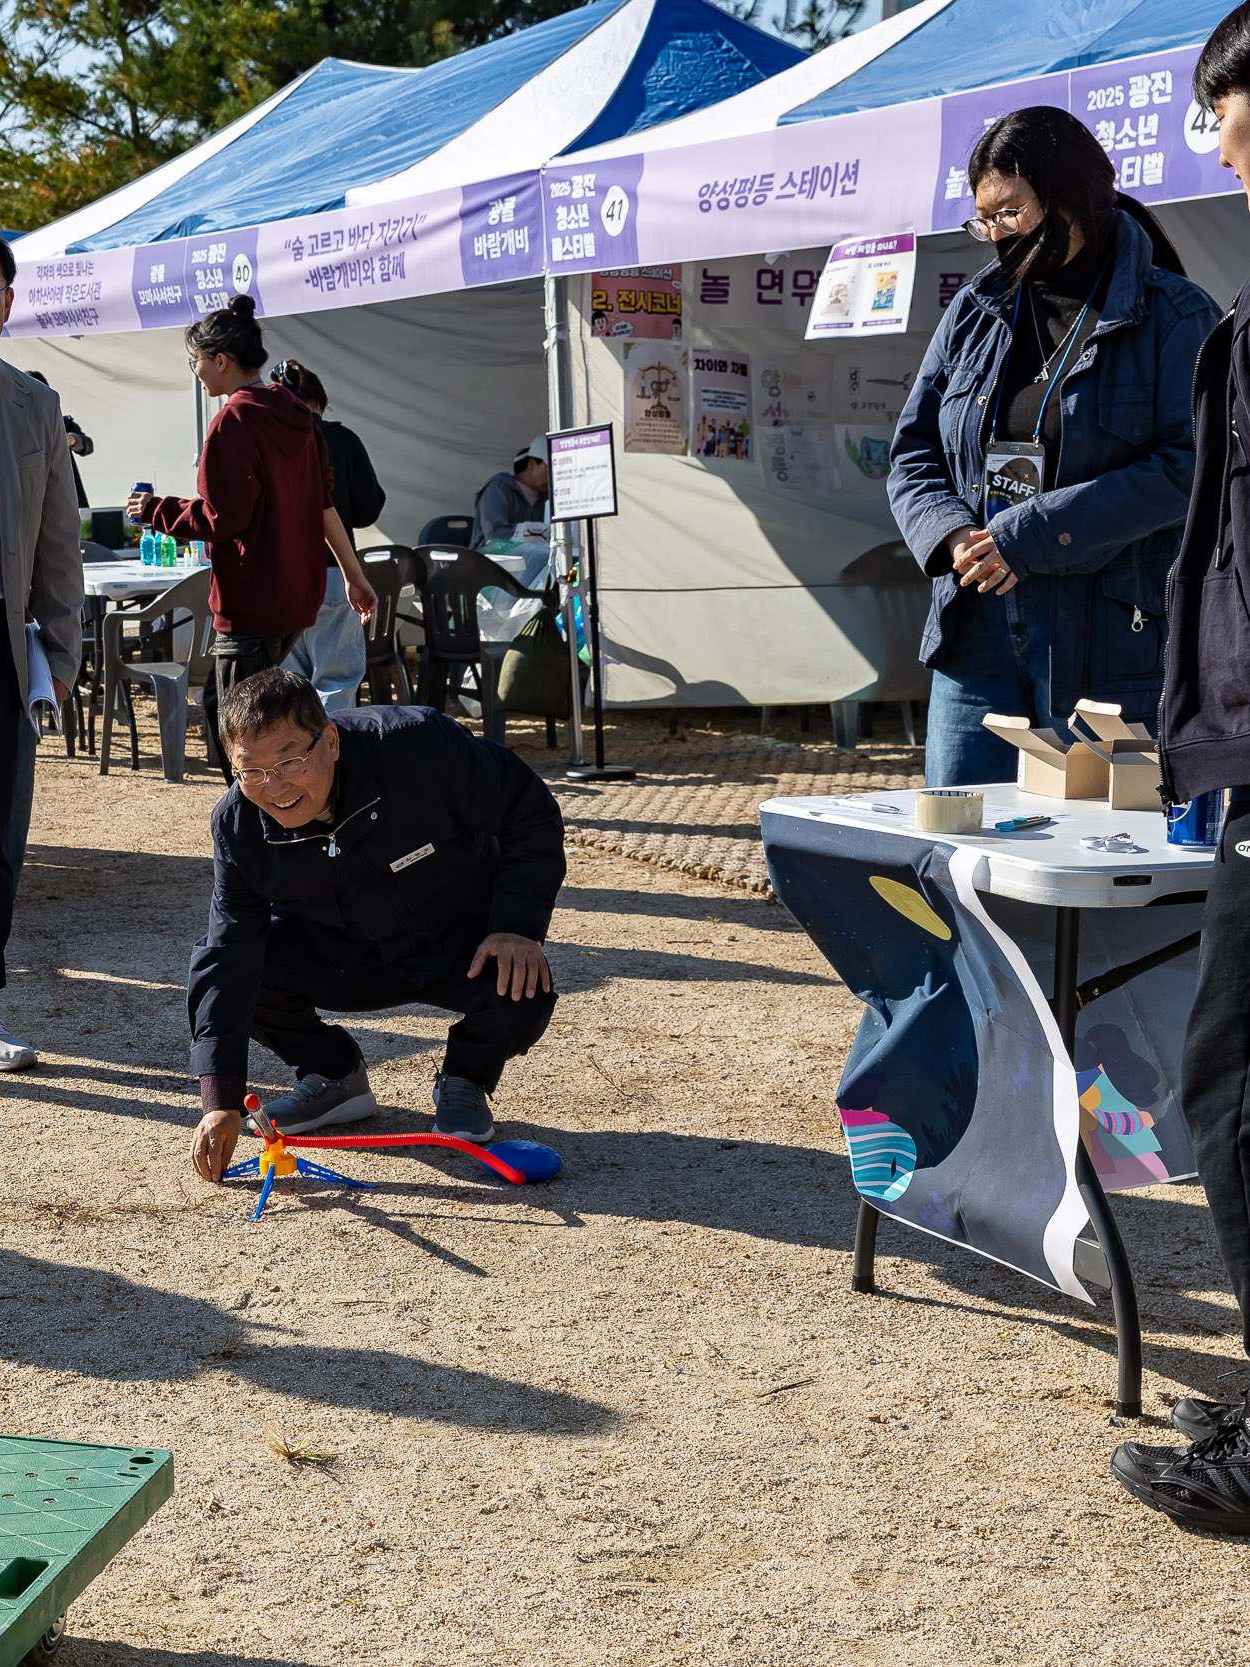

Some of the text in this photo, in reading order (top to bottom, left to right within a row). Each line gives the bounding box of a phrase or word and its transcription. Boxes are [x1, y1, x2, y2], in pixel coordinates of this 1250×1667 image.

[1087, 69, 1173, 111] 2025 광진
[1095, 112, 1159, 152] 청소년
[550, 173, 596, 199] 2025 광진
[698, 158, 860, 213] 양성평등 스테이션
[556, 203, 589, 231] 청소년
[606, 199, 623, 221] 41
[307, 230, 344, 257] 고르고
[349, 223, 375, 252] 바다
[473, 225, 529, 260] 바람개비
[551, 233, 596, 261] 페스티벌
[192, 243, 226, 264] 2025 광진
[37, 264, 55, 281] 각자의
[56, 262, 74, 279] 색으로
[195, 268, 224, 290] 청소년
[235, 265, 250, 282] 40
[304, 251, 406, 294] -바람개비와 함께
[65, 281, 102, 304] 작은도서관
[592, 290, 681, 315] 2. 전시코너
[694, 358, 728, 373] 차이와
[992, 474, 1036, 497] STAFF
